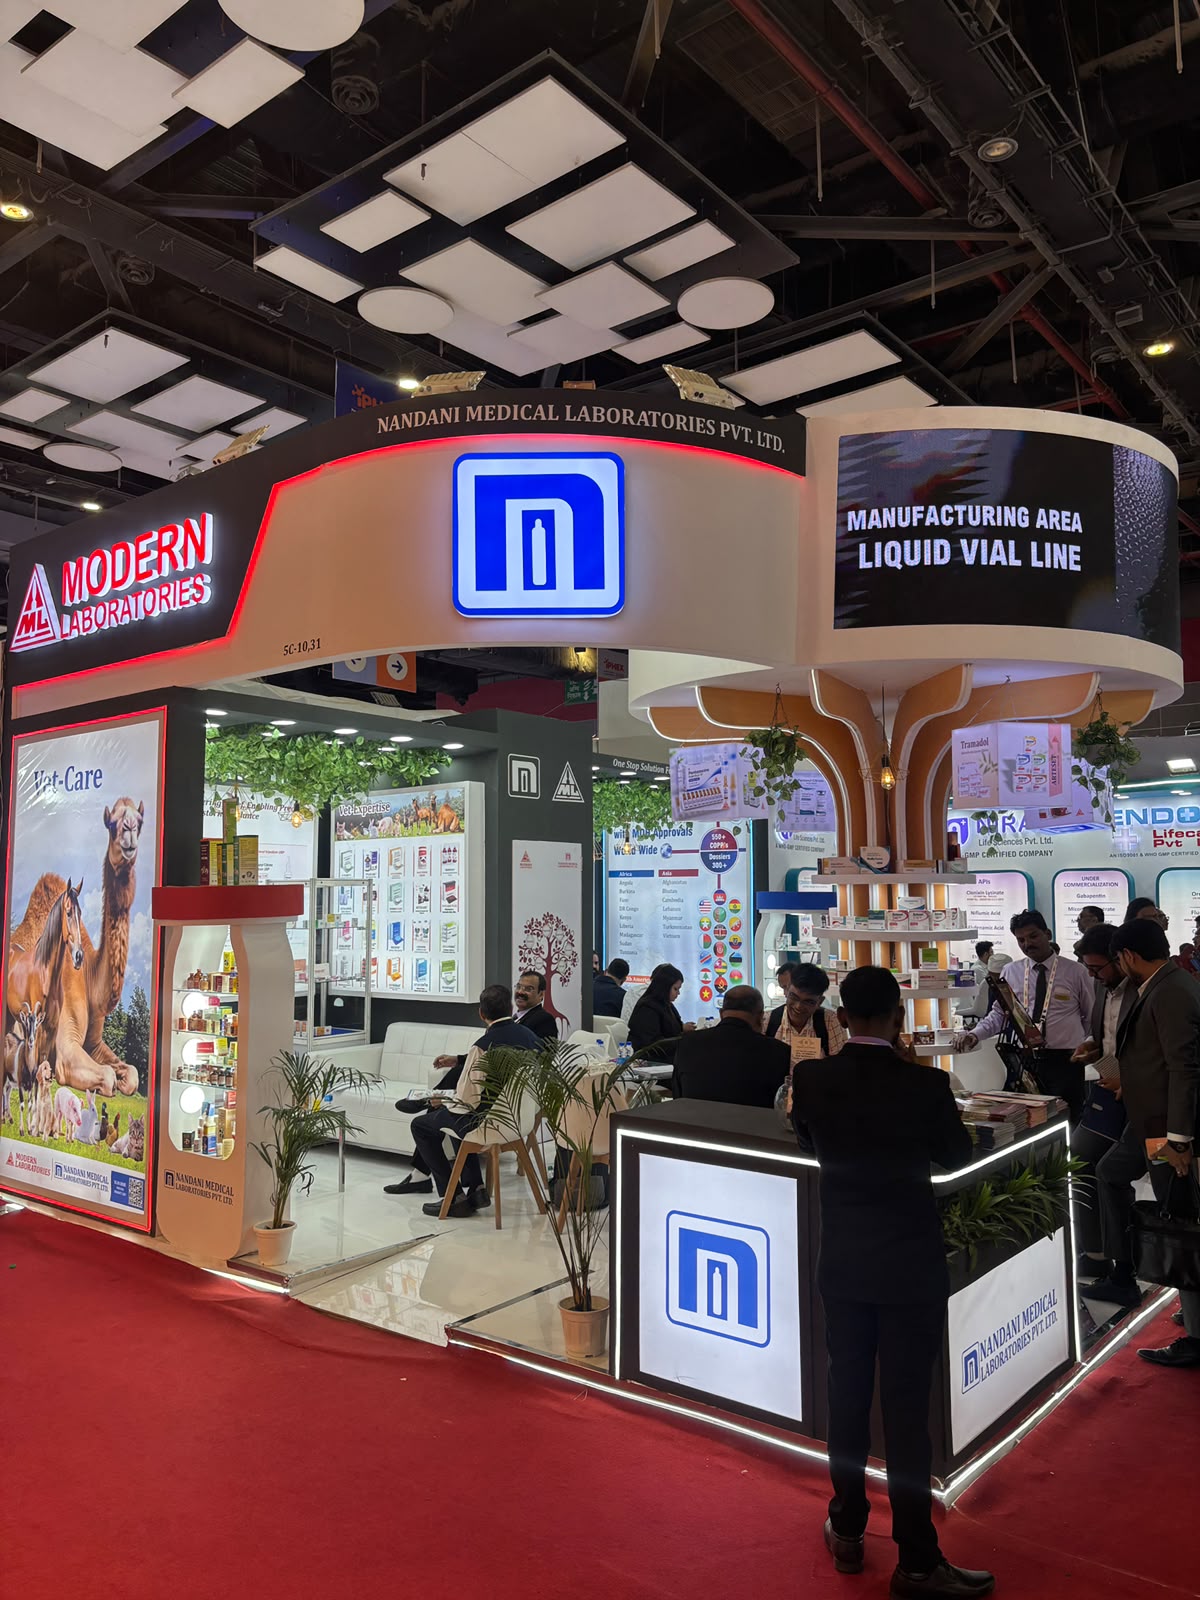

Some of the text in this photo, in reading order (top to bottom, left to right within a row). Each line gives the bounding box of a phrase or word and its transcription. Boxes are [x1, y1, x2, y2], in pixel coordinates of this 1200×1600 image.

[377, 404, 785, 453] NANDANI MEDICAL LABORATORIES PVT. LTD.
[847, 504, 1083, 533] MANUFACTURING AREA
[62, 512, 212, 606] MODERN
[858, 538, 1082, 571] LIQUID VIAL LINE
[60, 573, 211, 639] LABORATORIES
[283, 638, 321, 656] 5C-10,31
[960, 737, 989, 749] Tramadol
[612, 758, 626, 768] One
[626, 760, 640, 772] Stop
[640, 763, 665, 775] Solution
[339, 801, 391, 817] Vet-Expertise
[653, 827, 693, 839] Approvals
[978, 839, 991, 847] Life
[1024, 837, 1038, 845] Pvt.
[1040, 836, 1053, 845] Ltd.
[638, 845, 658, 855] Wide
[1153, 839, 1183, 848] Pvt
[1020, 849, 1053, 857] COMPANY
[15, 1152, 37, 1165] MODERN
[15, 1160, 51, 1176] LABORATORIES
[63, 1165, 109, 1184] NANDANI MEDICAL
[175, 1172, 234, 1196] NANDANI MEDICAL
[175, 1183, 211, 1199] LABORATORIES
[980, 1288, 1058, 1361] NANDANI MEDICAL
[980, 1310, 1058, 1381] LABORATORIES PVT. LTD.
